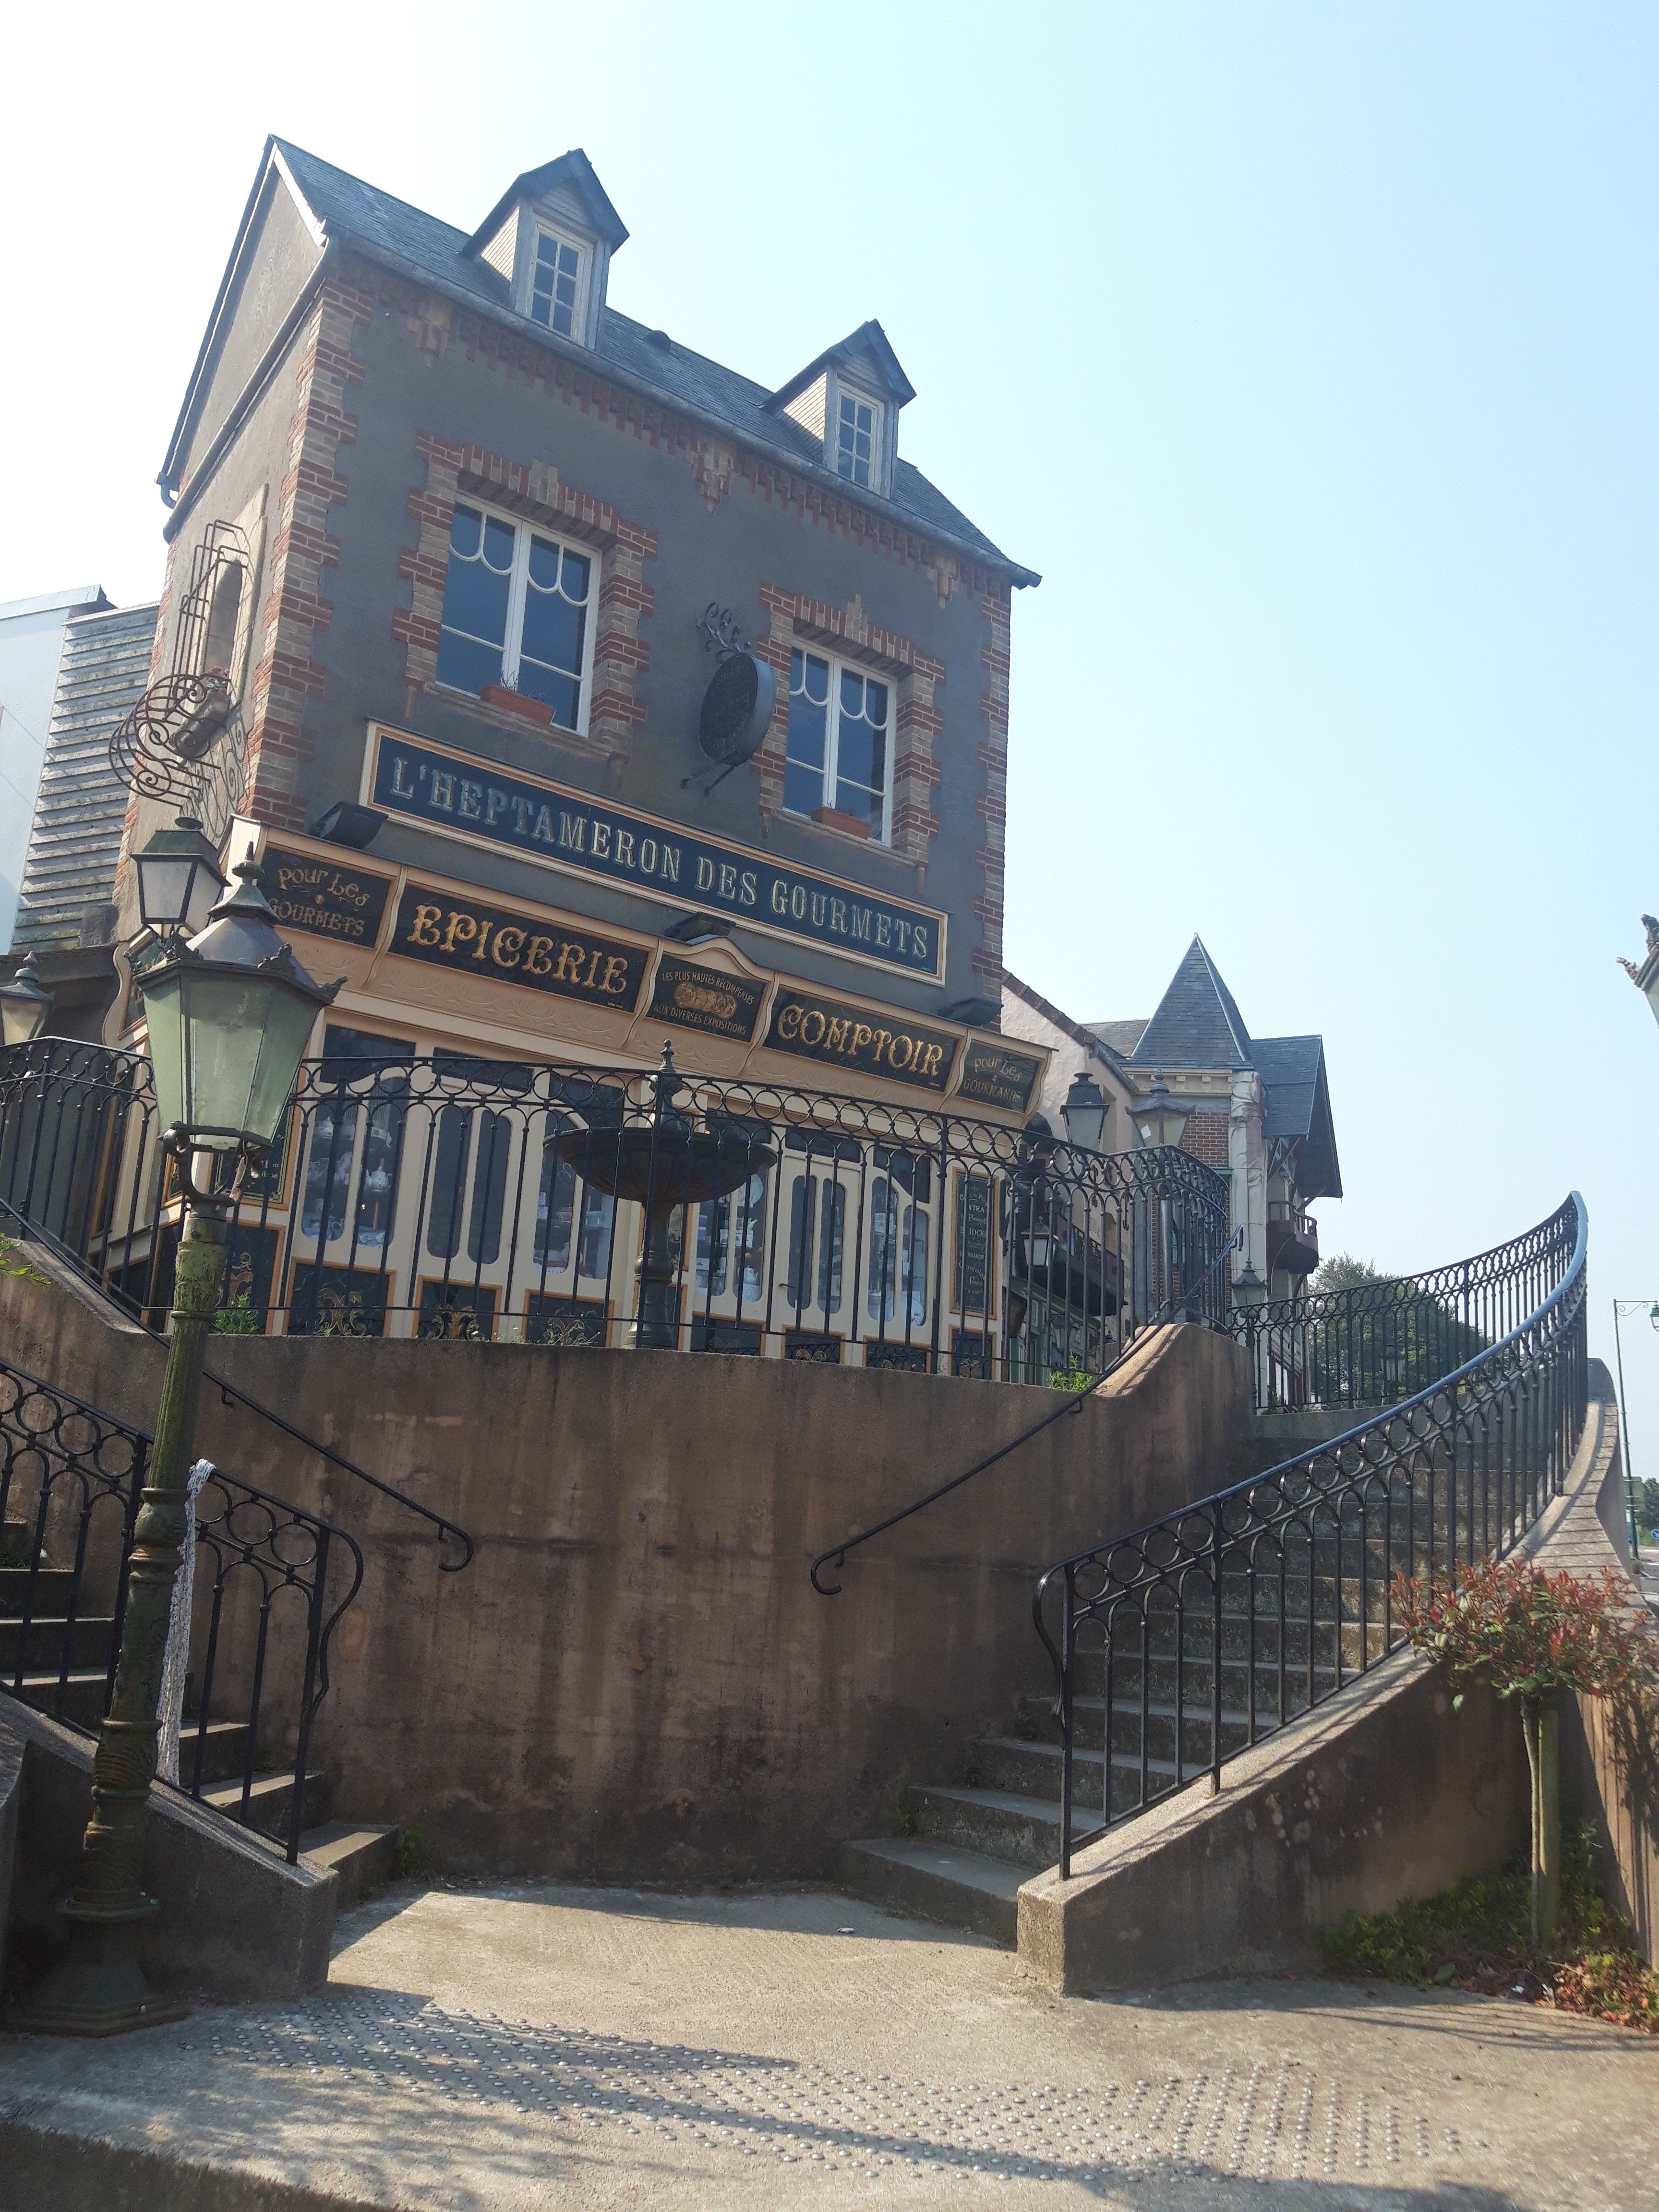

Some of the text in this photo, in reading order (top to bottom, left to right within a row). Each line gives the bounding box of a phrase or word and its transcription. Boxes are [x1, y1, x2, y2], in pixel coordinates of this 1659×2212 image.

[389, 756, 927, 958] L'HEPTAMERON DES GOURMETS
[407, 904, 628, 994] EPICERIE
[662, 972, 673, 982] LES
[675, 971, 691, 981] PLUS
[692, 972, 715, 985] HAUTES
[654, 1003, 747, 1034] AUX DIVERSES EXPOSITIONS
[777, 1004, 943, 1077] COMPTOIR
